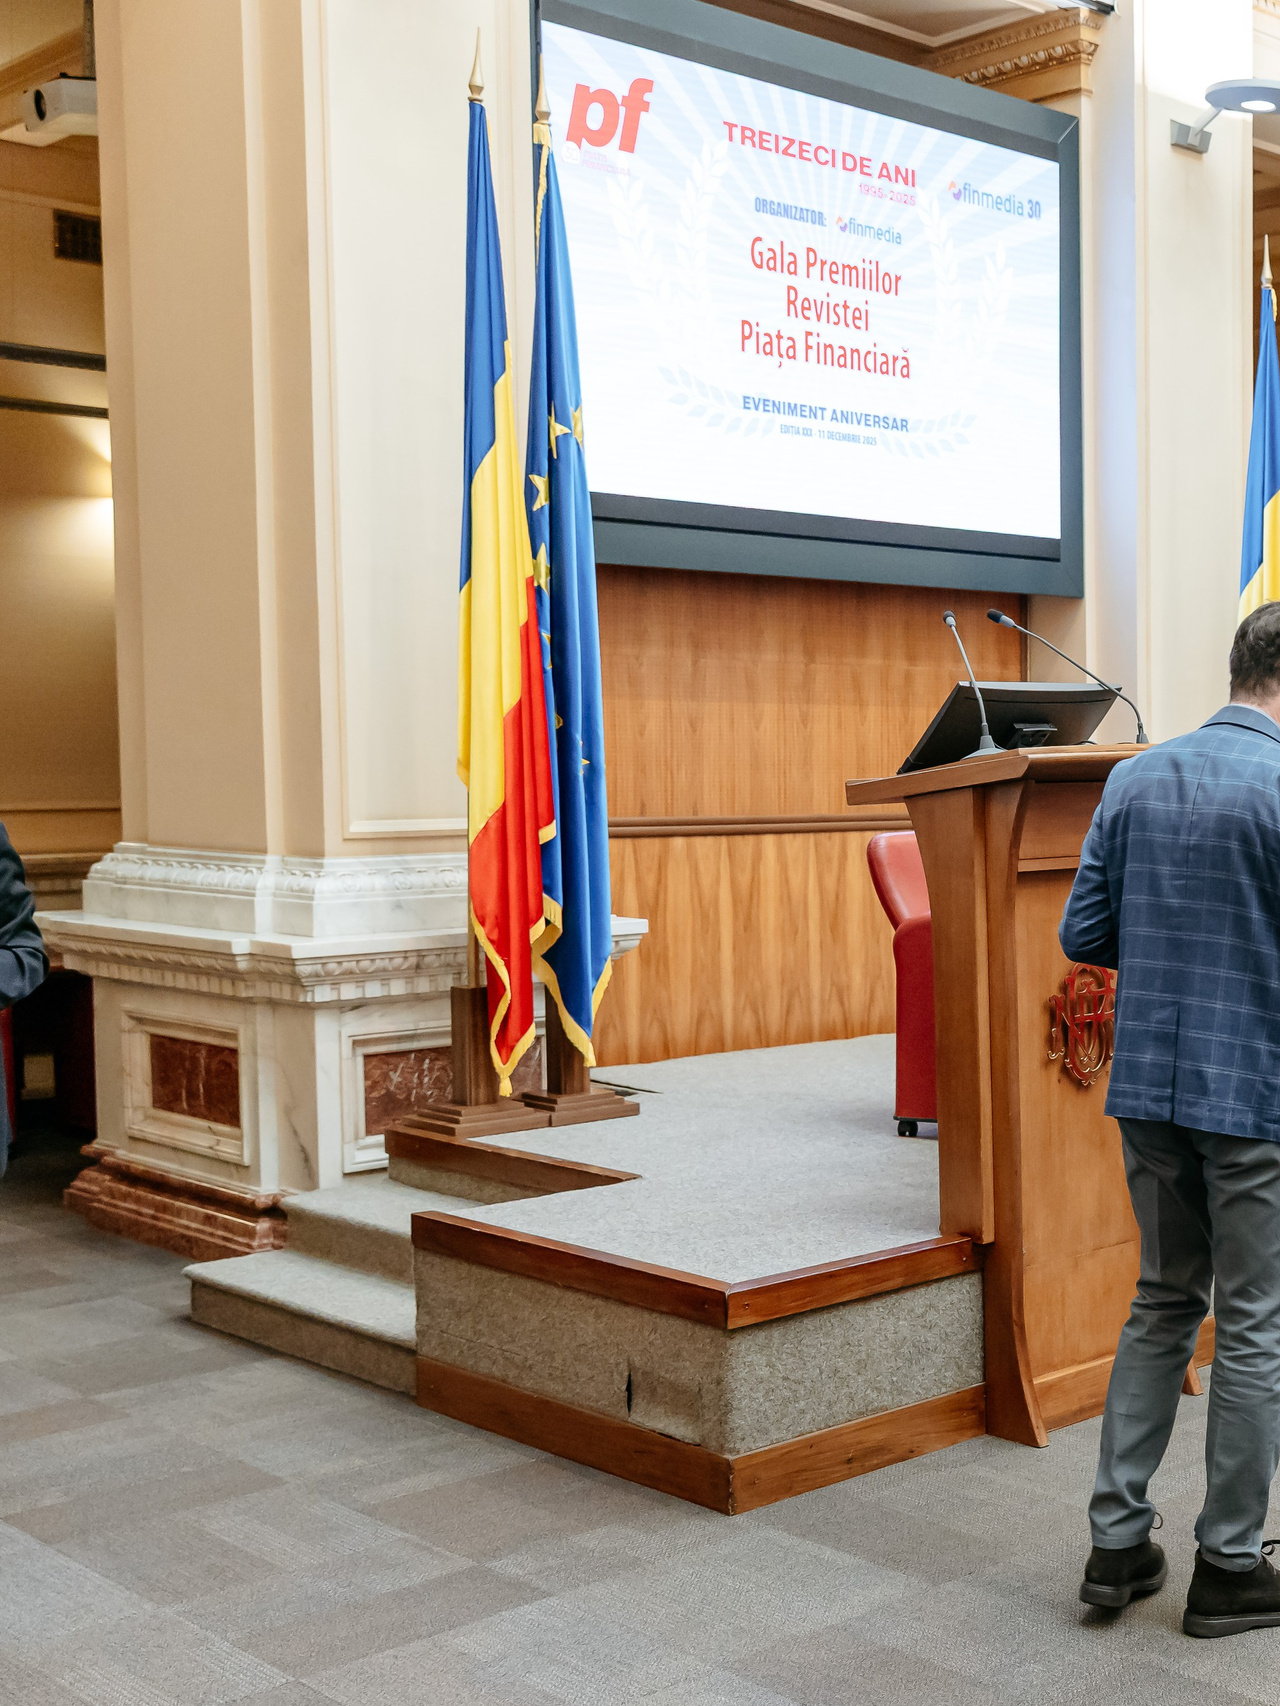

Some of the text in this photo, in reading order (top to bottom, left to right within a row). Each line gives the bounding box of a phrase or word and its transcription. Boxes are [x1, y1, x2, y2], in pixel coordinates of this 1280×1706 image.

[566, 78, 654, 154] pf
[723, 121, 916, 188] TREIZECI DE ANI
[755, 197, 827, 227] ORGANIZATOR:
[962, 182, 1041, 220] finmedia 30
[848, 218, 902, 245] finmedia
[750, 236, 901, 296] Gala Premiilor
[787, 285, 869, 331] Revistei
[741, 319, 910, 379] Piața Financiară
[742, 395, 909, 432] EVENIMENT ANIVERSAR
